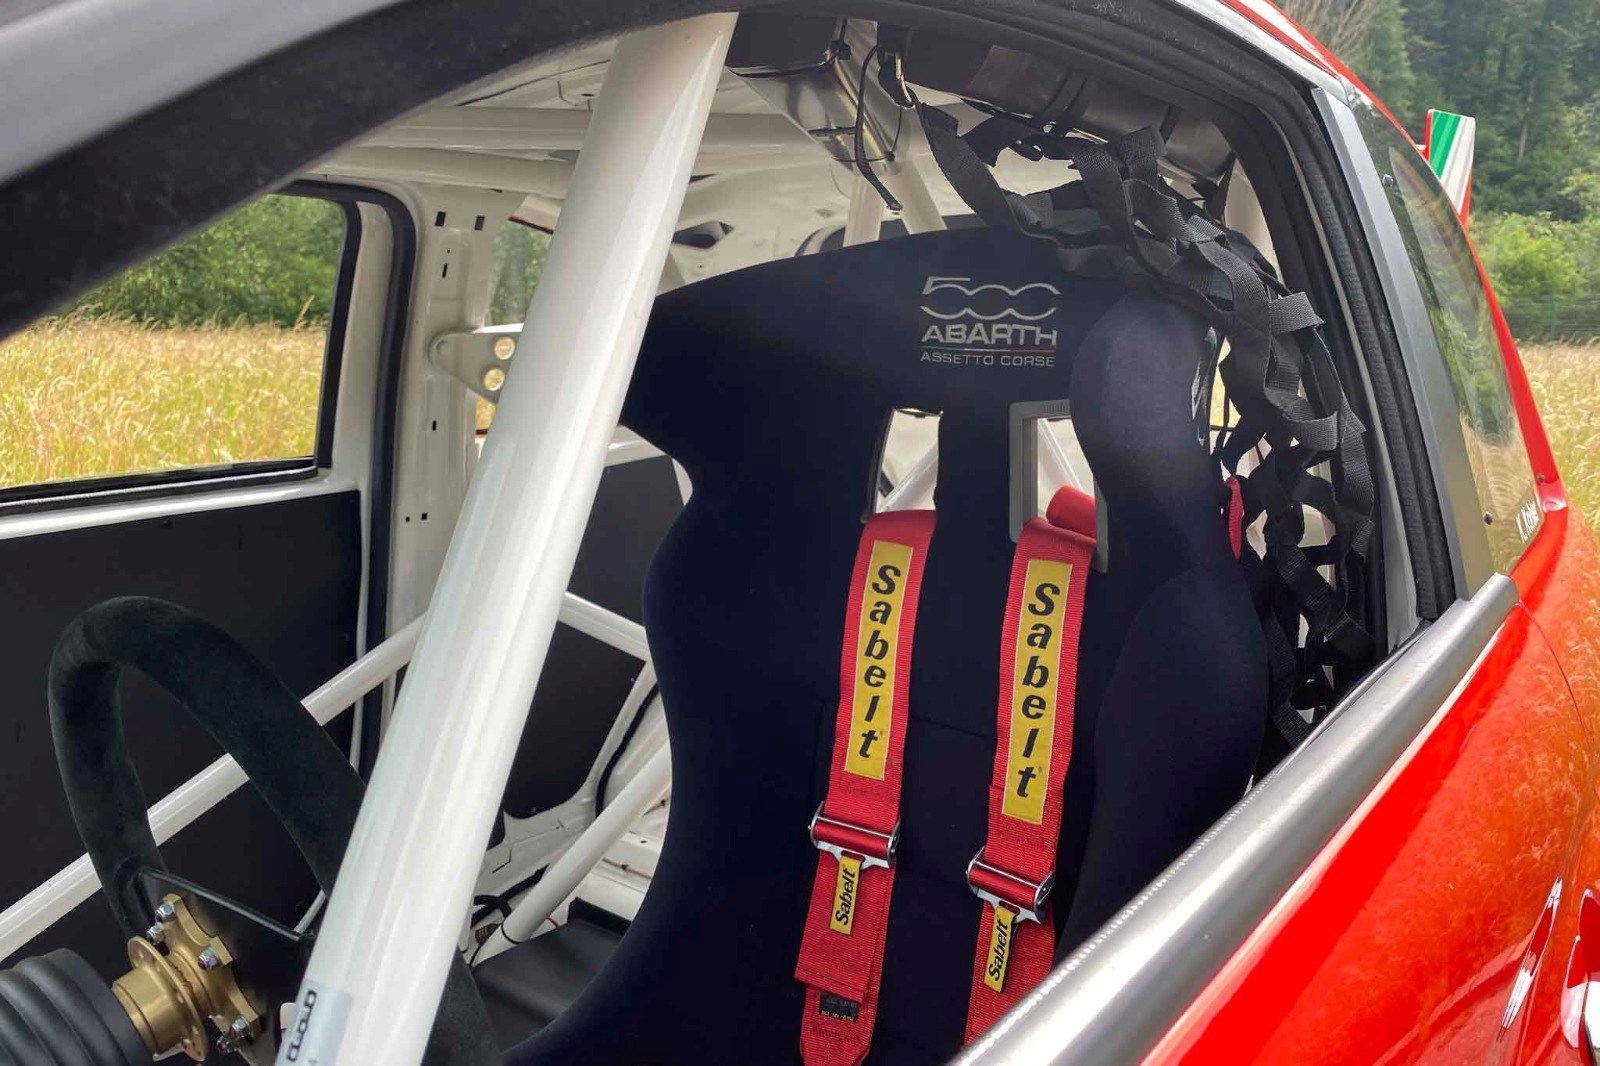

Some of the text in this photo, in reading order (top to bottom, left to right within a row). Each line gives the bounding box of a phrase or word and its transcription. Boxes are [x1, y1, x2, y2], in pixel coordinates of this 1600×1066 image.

[920, 276, 1062, 321] 500
[920, 351, 1056, 368] ASSETTO CORSE
[921, 323, 1058, 347] ABARTH
[858, 564, 902, 759] Sabelt
[1016, 582, 1061, 798] Sabelt
[835, 868, 856, 926] Sabelt
[988, 918, 1009, 982] Sabelt
